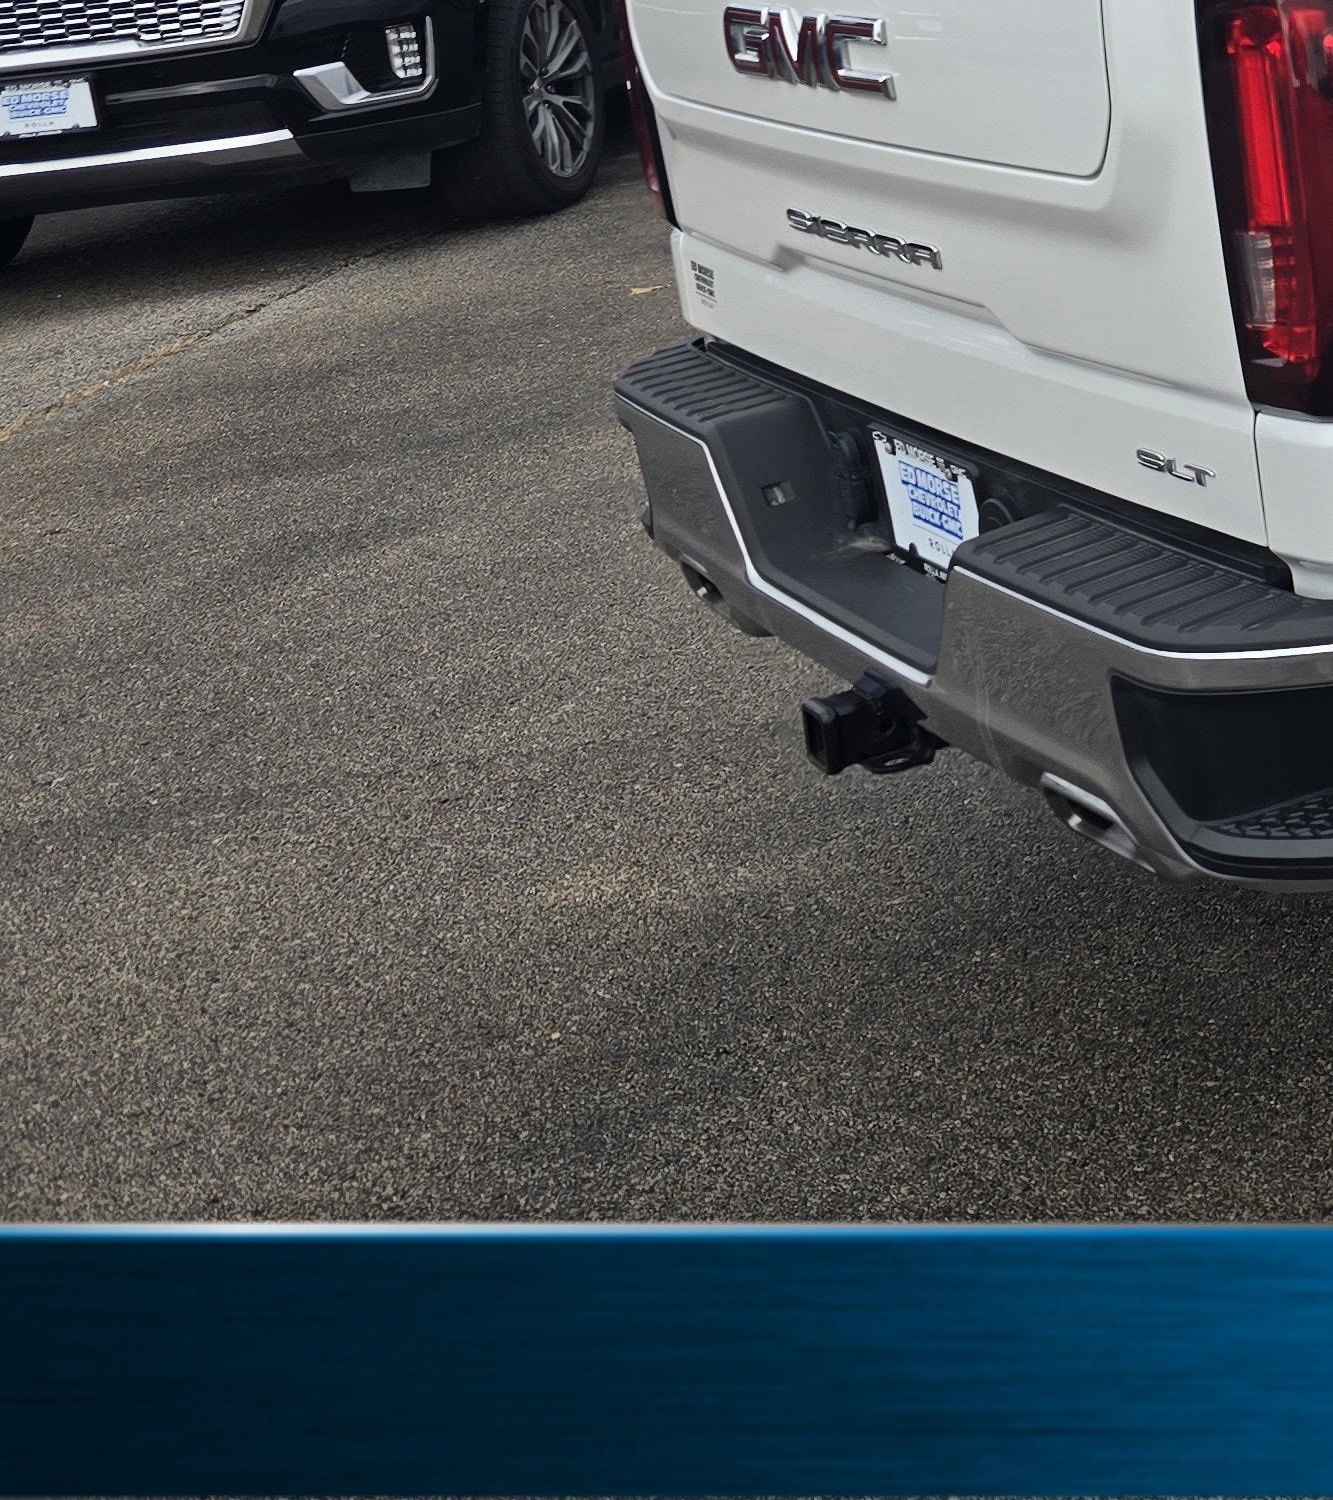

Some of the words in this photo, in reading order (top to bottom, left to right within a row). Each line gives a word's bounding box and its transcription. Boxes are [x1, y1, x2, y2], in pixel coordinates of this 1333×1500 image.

[723, 2, 898, 102] GMC
[786, 206, 943, 270] SIERRA
[899, 460, 917, 487] ED
[915, 467, 961, 510] MORSE
[1136, 448, 1216, 488] SLT
